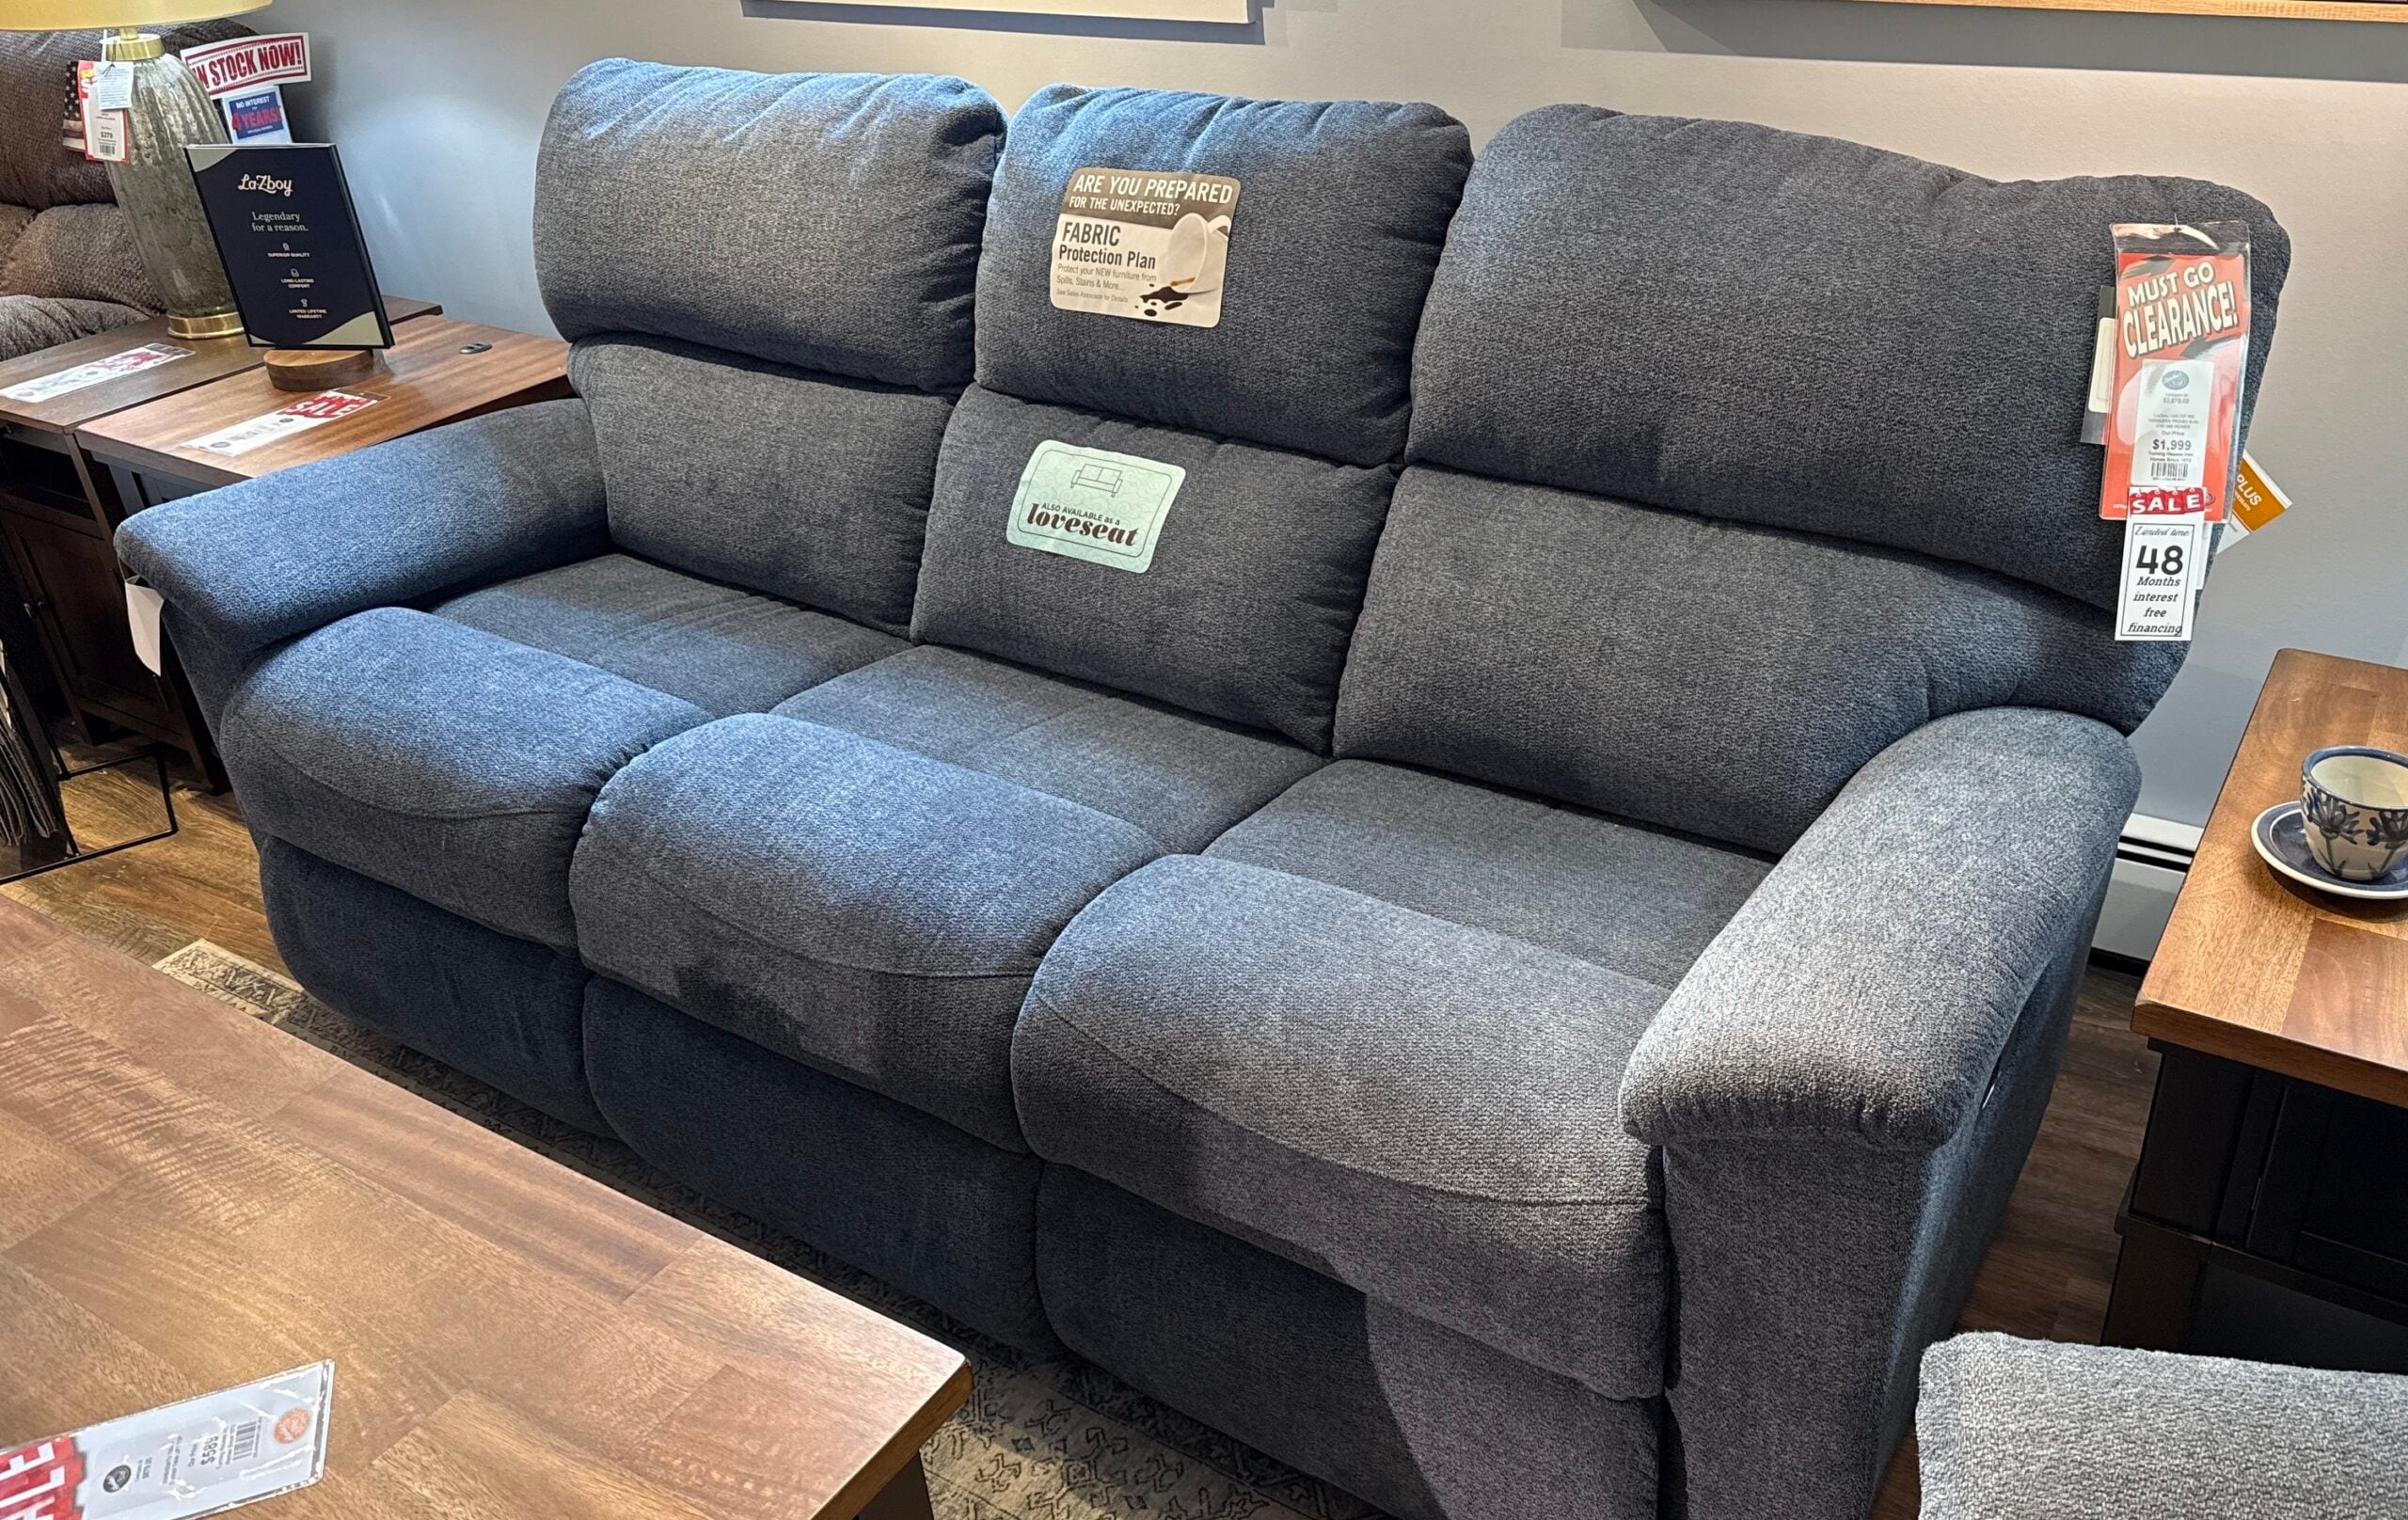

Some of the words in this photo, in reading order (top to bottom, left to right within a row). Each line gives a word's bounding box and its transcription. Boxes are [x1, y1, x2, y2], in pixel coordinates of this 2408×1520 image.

[209, 50, 257, 86] STOCK
[258, 41, 301, 71] NOW!
[245, 96, 270, 107] INTEREST
[232, 112, 242, 130] 4
[1073, 174, 1105, 193] ARE
[1110, 176, 1142, 196] YOU
[1144, 179, 1233, 204] PREPARED
[1069, 196, 1086, 209] FOR
[1089, 197, 1107, 210] THE
[1110, 198, 1180, 215] UNEXPECTED?
[251, 212, 300, 222] Legendary
[251, 222, 265, 231] for
[1062, 221, 1121, 246] FABRIC
[1059, 244, 1122, 266] Protection
[1127, 250, 1156, 270] Plan
[1056, 275, 1073, 285] Spills,
[1076, 277, 1095, 288] Stains
[1057, 262, 1079, 274] Protect
[1095, 267, 1111, 277] NEW
[1113, 269, 1140, 279] furniture
[1142, 272, 1157, 282] from
[2127, 272, 2178, 308] MUST
[2183, 261, 2215, 288] GO
[2123, 280, 2239, 358] CLEARANCE!
[285, 401, 360, 416] SALE
[2152, 438, 2192, 451] $1,999
[2237, 473, 2262, 506] PLUS
[1040, 502, 1061, 512] ALSO
[1062, 505, 1102, 522] AVAILABLE
[2131, 494, 2201, 514] SALE
[1026, 502, 1139, 546] loveseat
[2134, 526, 2171, 536] Limited
[2135, 545, 2184, 576] 48
[2136, 577, 2181, 587] Months
[2132, 591, 2179, 603] interest
[2144, 607, 2167, 618] free
[2128, 622, 2182, 637] financing
[200, 1435, 219, 1465] $589
